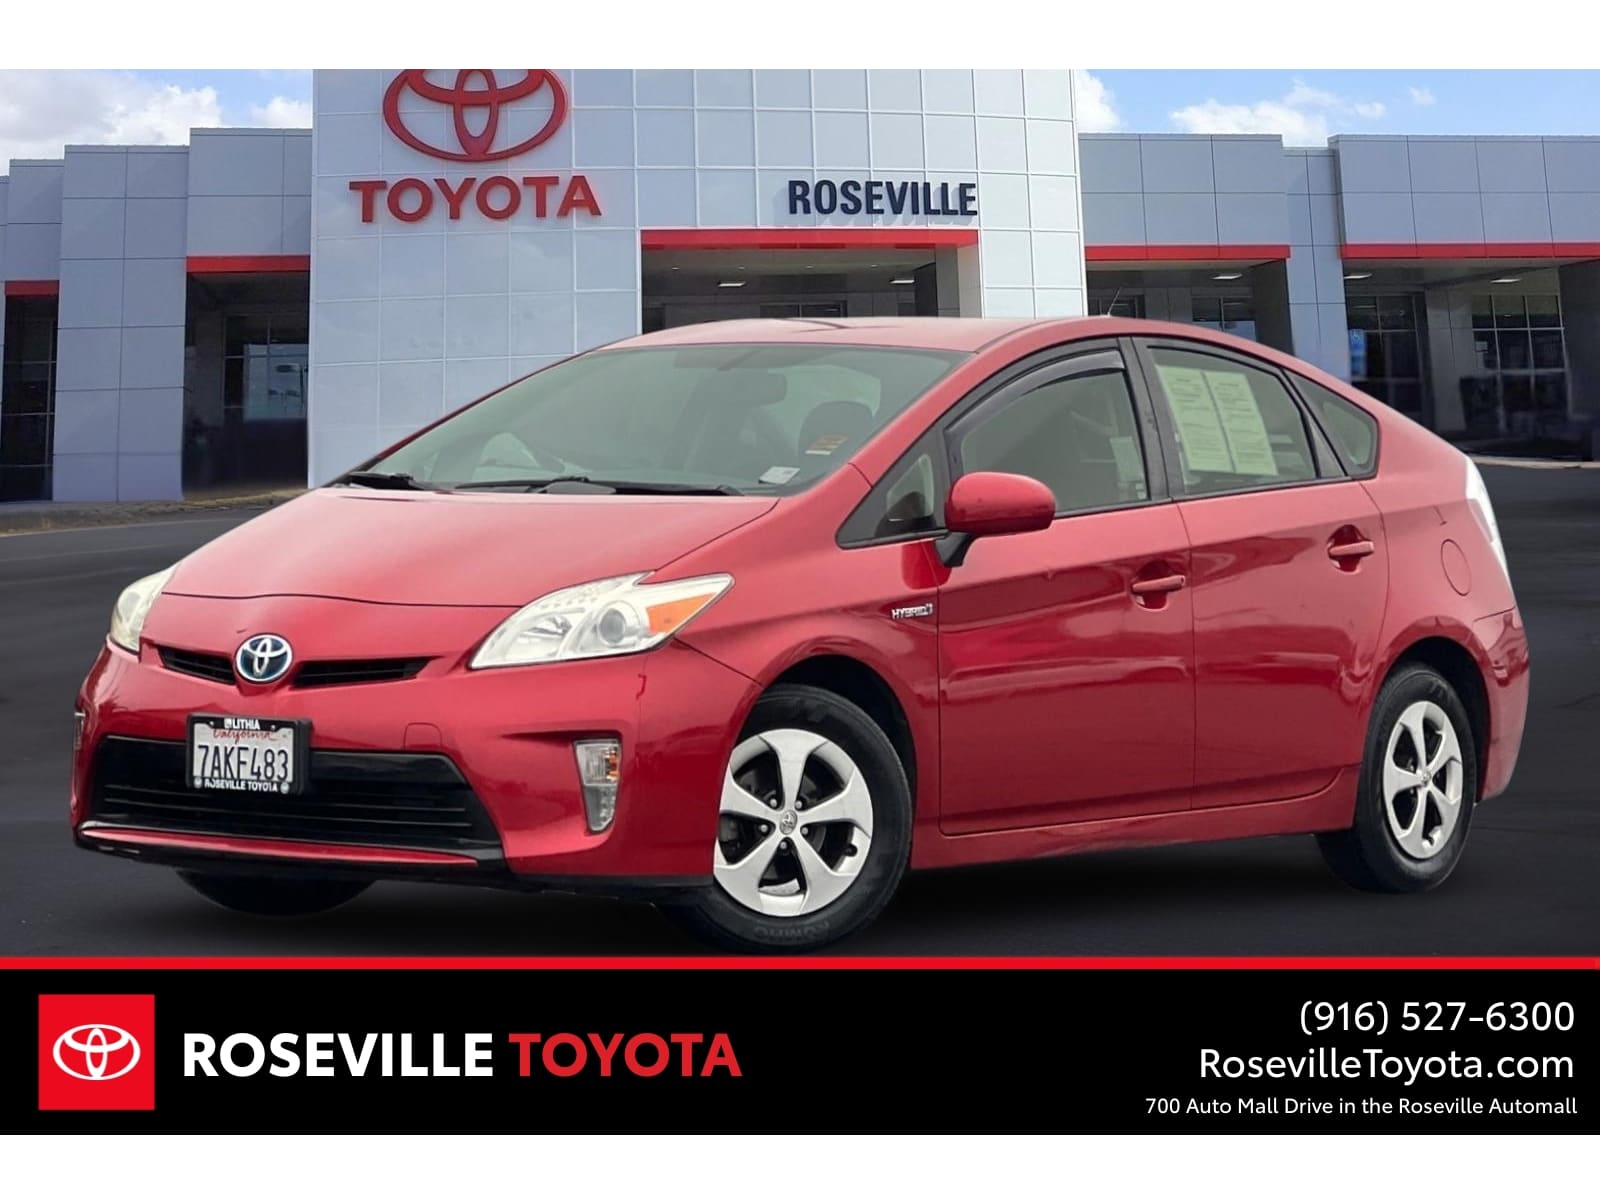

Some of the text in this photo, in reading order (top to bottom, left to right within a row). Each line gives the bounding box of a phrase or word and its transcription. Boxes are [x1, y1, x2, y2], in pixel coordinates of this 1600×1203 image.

[349, 175, 602, 223] TOYOTA
[788, 179, 978, 217] ROSEVILLE
[232, 718, 260, 730] LITHIA
[198, 745, 288, 782] 7AKF483
